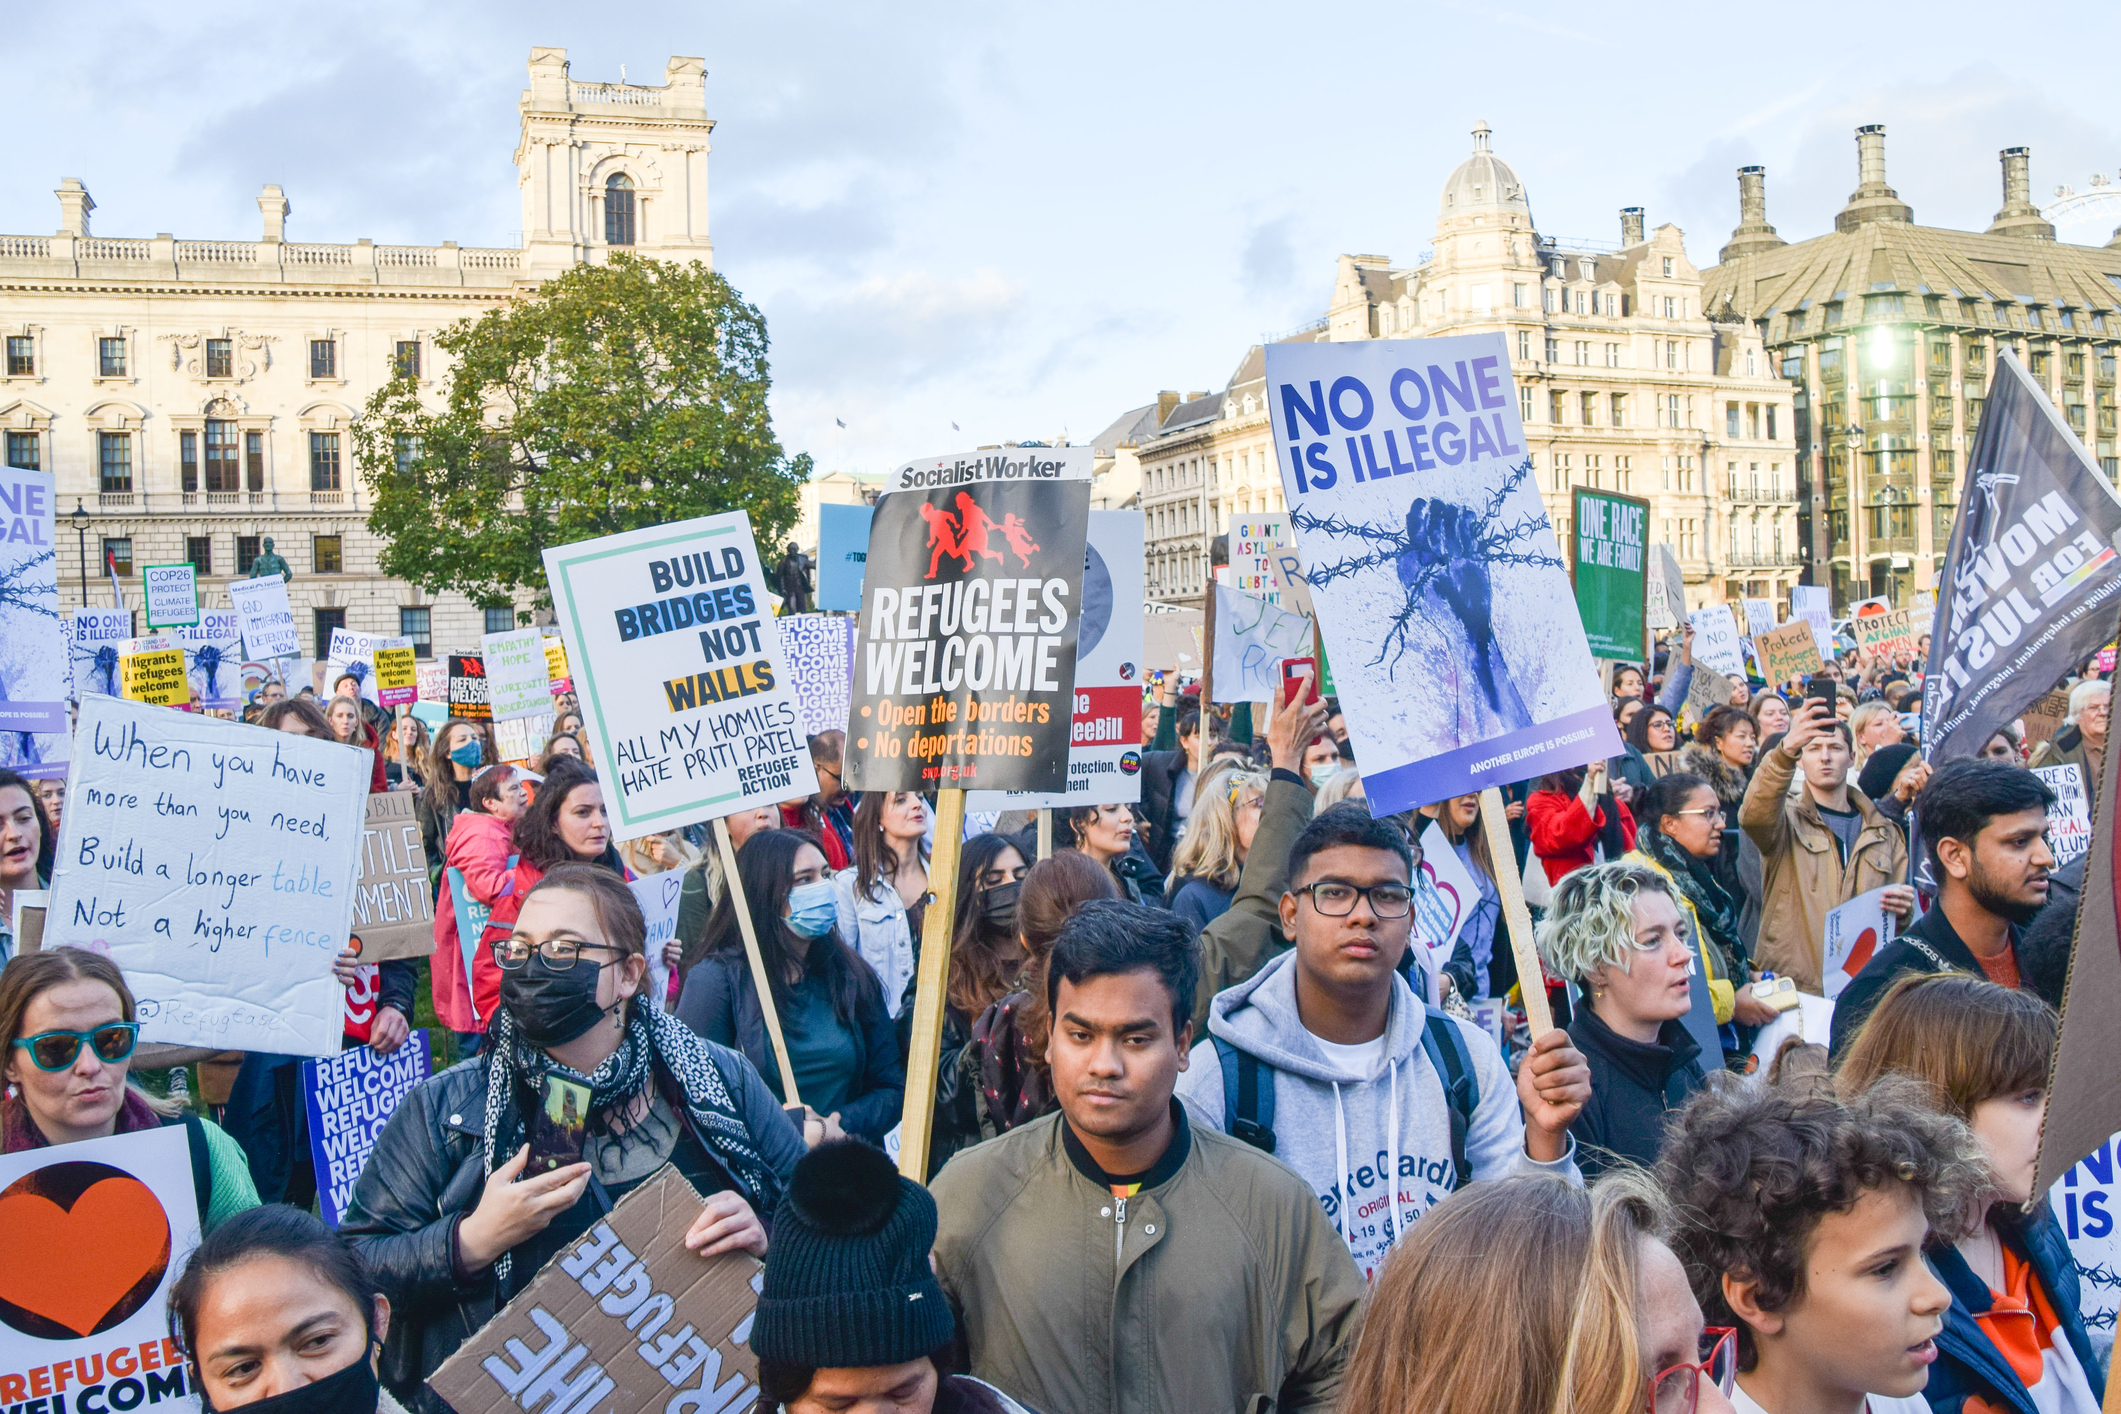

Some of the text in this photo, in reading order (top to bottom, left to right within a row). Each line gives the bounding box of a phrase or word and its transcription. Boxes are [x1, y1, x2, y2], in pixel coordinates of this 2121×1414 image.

[1280, 355, 1506, 441] NO ONE
[1290, 413, 1520, 494] IS ILLEGAL
[1241, 524, 1280, 538] GRANT
[1580, 496, 1643, 547] ONE RACE
[1580, 536, 1642, 572] WE ARE FAMILY
[648, 546, 745, 594] BUILD
[1255, 558, 1268, 571] TO
[150, 570, 191, 582] COP26
[151, 584, 191, 594] PROTECT
[232, 584, 255, 593] Medical
[264, 580, 283, 588] Justice
[154, 597, 191, 607] CLIMATE
[242, 600, 263, 614] END
[870, 577, 1069, 640] REFUGEES
[1747, 602, 1768, 618] SHUT
[77, 615, 129, 629] NO ONE
[150, 607, 196, 618] REFUGEES
[204, 615, 238, 628] ONE
[614, 584, 756, 643] BRIDGES
[1856, 609, 1910, 633] PROTECT
[76, 627, 130, 641] IS ILLEGAL
[189, 628, 239, 640] ILLEGAL
[776, 616, 847, 633] EFUGEES
[1864, 622, 1911, 643] AFGHAN
[334, 635, 355, 646] NO
[488, 636, 536, 655] EMPATHY
[699, 620, 762, 663] NOT
[780, 628, 848, 646] ELCOME
[1707, 630, 1728, 646] NO
[1762, 627, 1808, 653] Protect
[1865, 635, 1913, 656] WOMEN
[272, 641, 294, 654] NOW
[332, 645, 342, 654] IS
[378, 650, 410, 660] Migrants
[1769, 646, 1816, 669] Refugee
[127, 653, 177, 670] Migrants
[383, 659, 414, 669] refugees
[502, 653, 531, 666] HOPE
[865, 634, 1062, 696] WELCOME
[1712, 661, 1739, 674] BACK
[124, 666, 183, 682] & refugees
[381, 668, 411, 677] welcome
[388, 678, 405, 686] here
[417, 666, 447, 679] here
[426, 677, 447, 688] the
[130, 679, 180, 694] welcome
[662, 660, 776, 713] WALLS
[144, 694, 169, 704] here
[20, 711, 50, 719] POSSIBLE
[877, 699, 926, 732] Open
[931, 695, 958, 724] the
[964, 694, 1050, 724] borders
[617, 736, 656, 767] ALL
[660, 719, 701, 754] MY
[708, 701, 796, 742] HOMIES
[94, 720, 326, 789] When you have
[874, 728, 1034, 764] No deportations
[1470, 727, 1596, 775] ANOTHER EUROPE IS POSSIBLE
[621, 728, 806, 797] HATE PRITI PATEL
[737, 755, 799, 782] REFUGEE
[921, 762, 977, 782] swp.org.uk
[1070, 760, 1117, 775] otection,
[2064, 766, 2077, 782] IS
[741, 772, 792, 797] ACTION
[87, 788, 330, 842] more than you need,
[373, 797, 411, 818] BILL
[2049, 818, 2089, 837] EGAL
[358, 826, 425, 880] TILE
[2049, 834, 2089, 853] YLUM
[79, 836, 334, 910] Build a longer table
[1424, 882, 1451, 928] ugees
[73, 897, 331, 958] Not a higher fence
[1416, 893, 1448, 942] elcome
[1902, 936, 1939, 961] adidas
[314, 1051, 425, 1114] WELCOME
[321, 1076, 424, 1138] REFUGE
[2064, 1138, 2121, 1187] N
[1358, 1191, 1415, 1219] ORIGIAL
[2065, 1190, 2113, 1240] IS
[1361, 1208, 1420, 1238] 19 50
